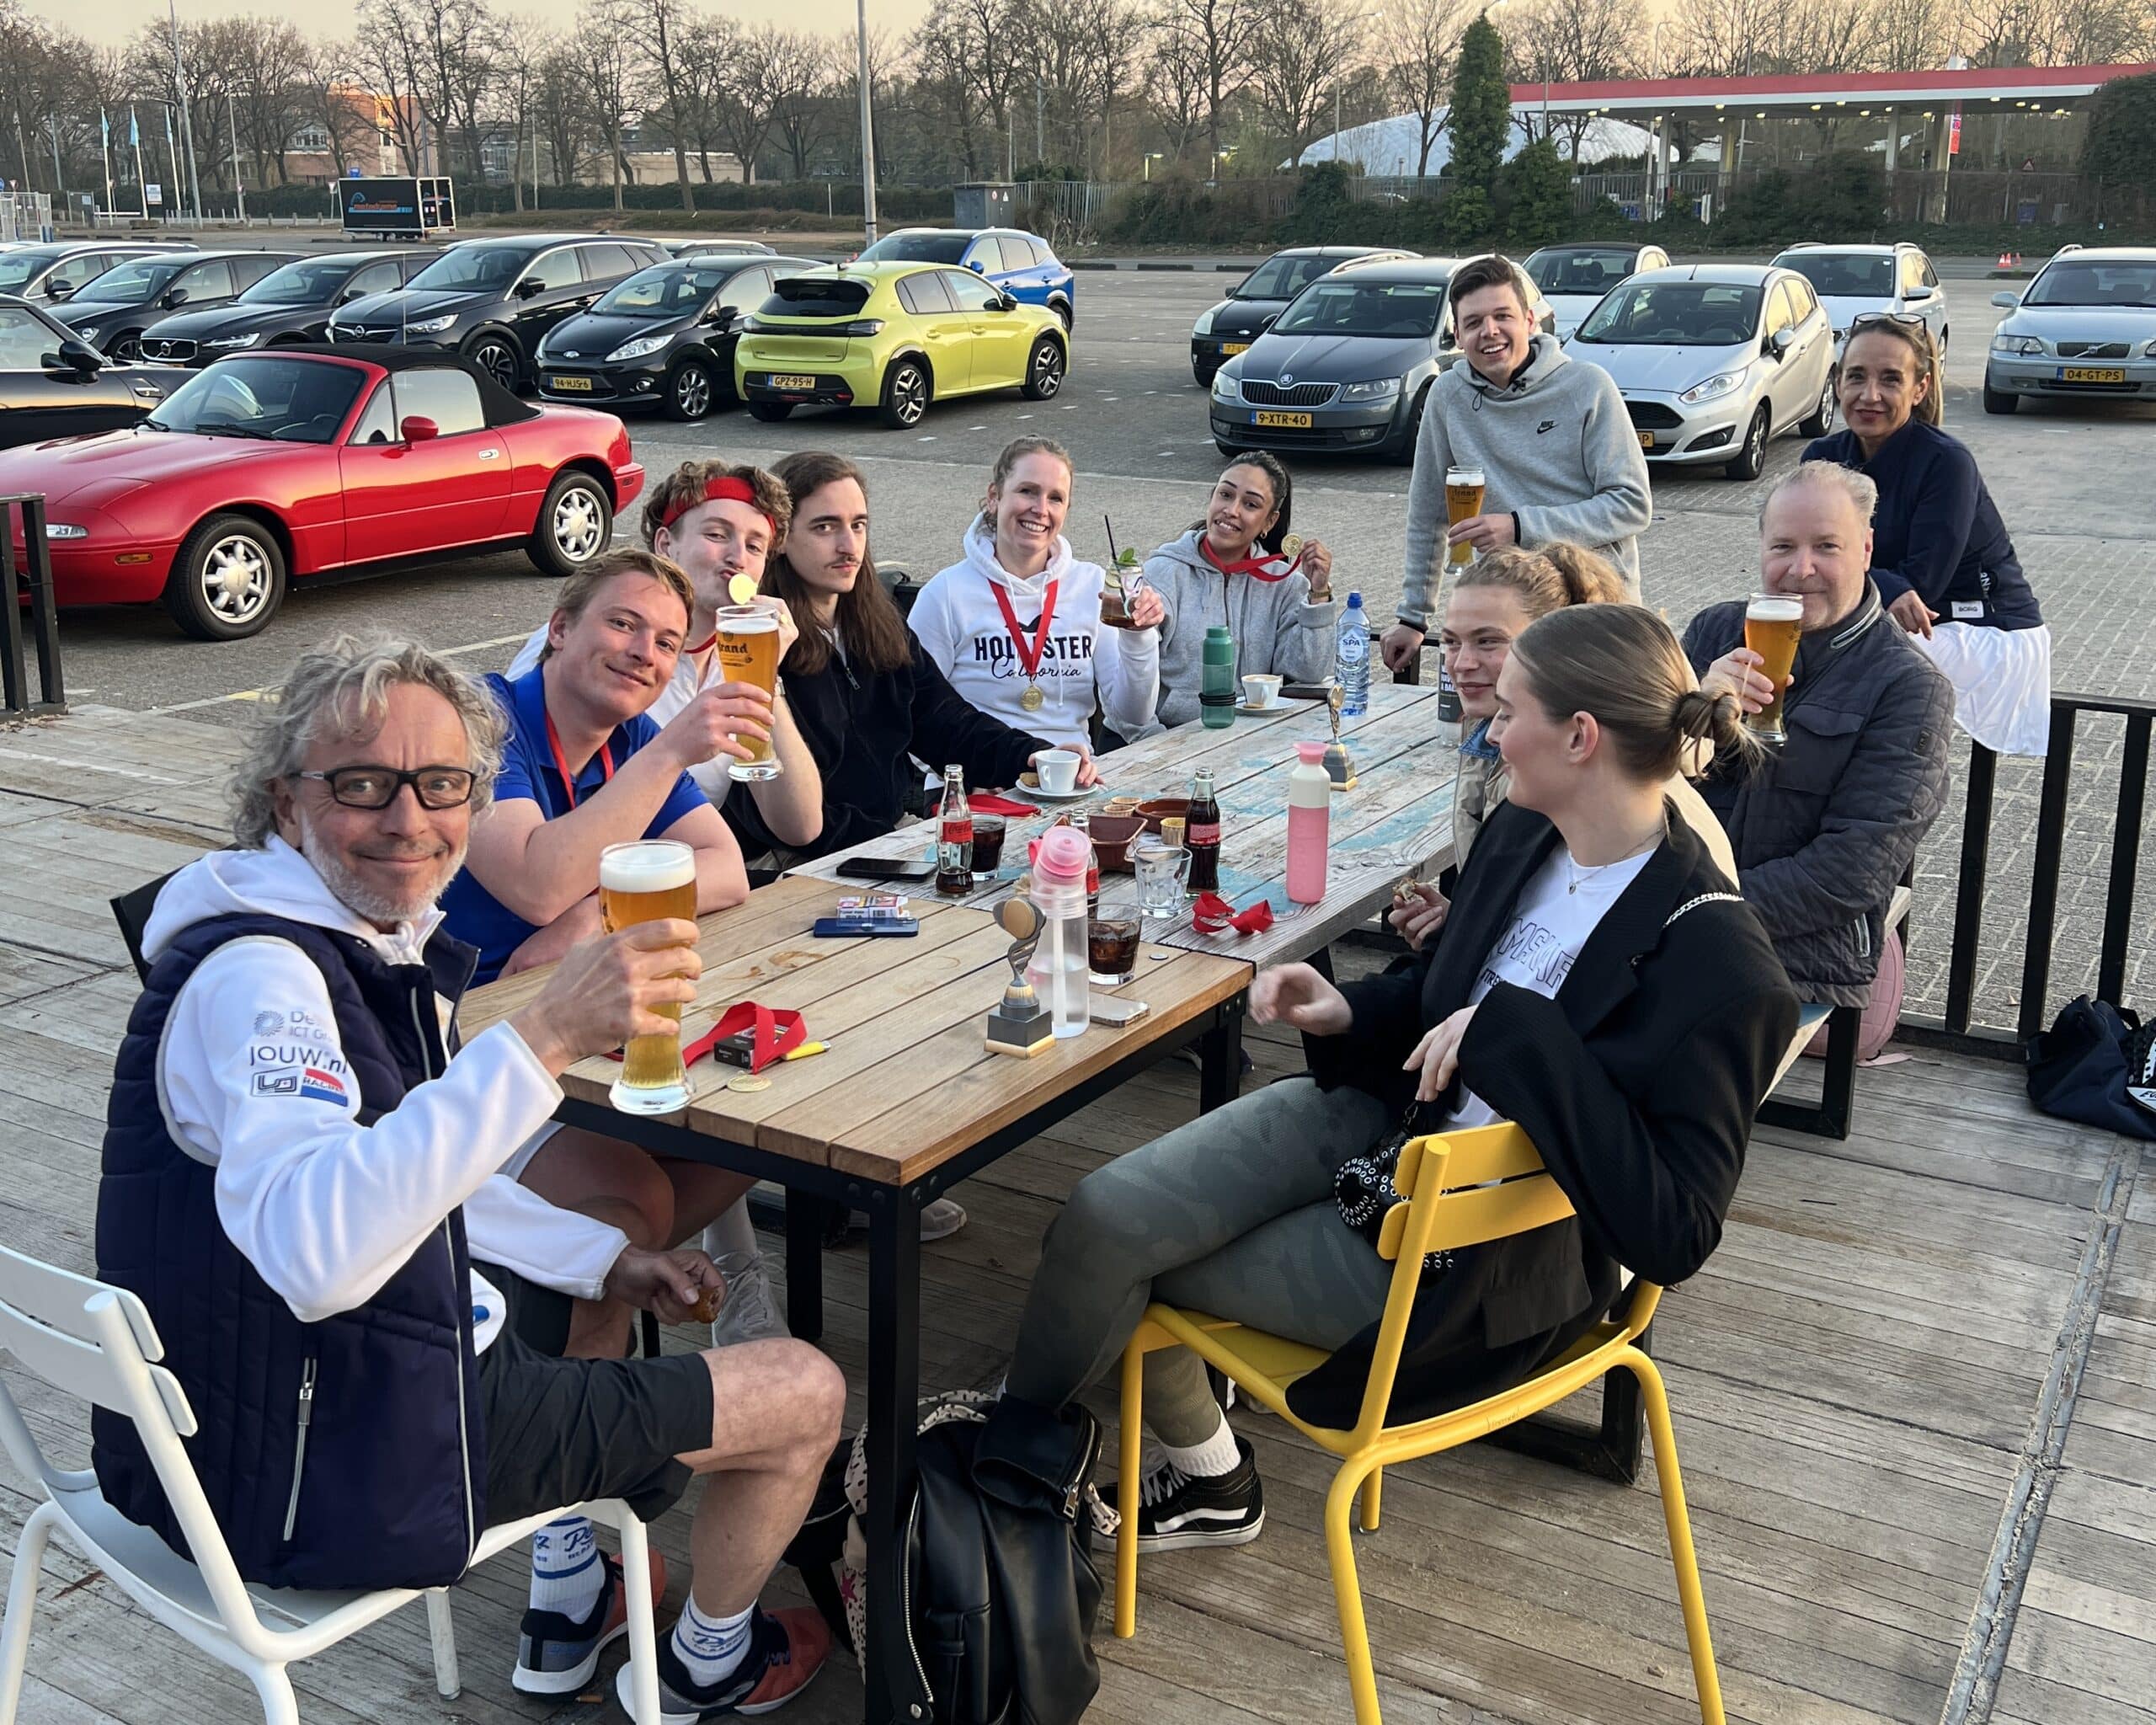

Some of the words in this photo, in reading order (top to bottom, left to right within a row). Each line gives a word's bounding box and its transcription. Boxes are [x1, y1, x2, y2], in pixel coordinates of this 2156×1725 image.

[2067, 370, 2120, 381] 04-GT-PS
[554, 378, 590, 388] 94-HJS-6
[774, 376, 813, 387] GPZ-95-H
[1258, 413, 1307, 425] 9-XTR-40
[974, 635, 1092, 661] HOLSTER
[1342, 638, 1361, 647] SPA
[991, 655, 1082, 681] Caliornia
